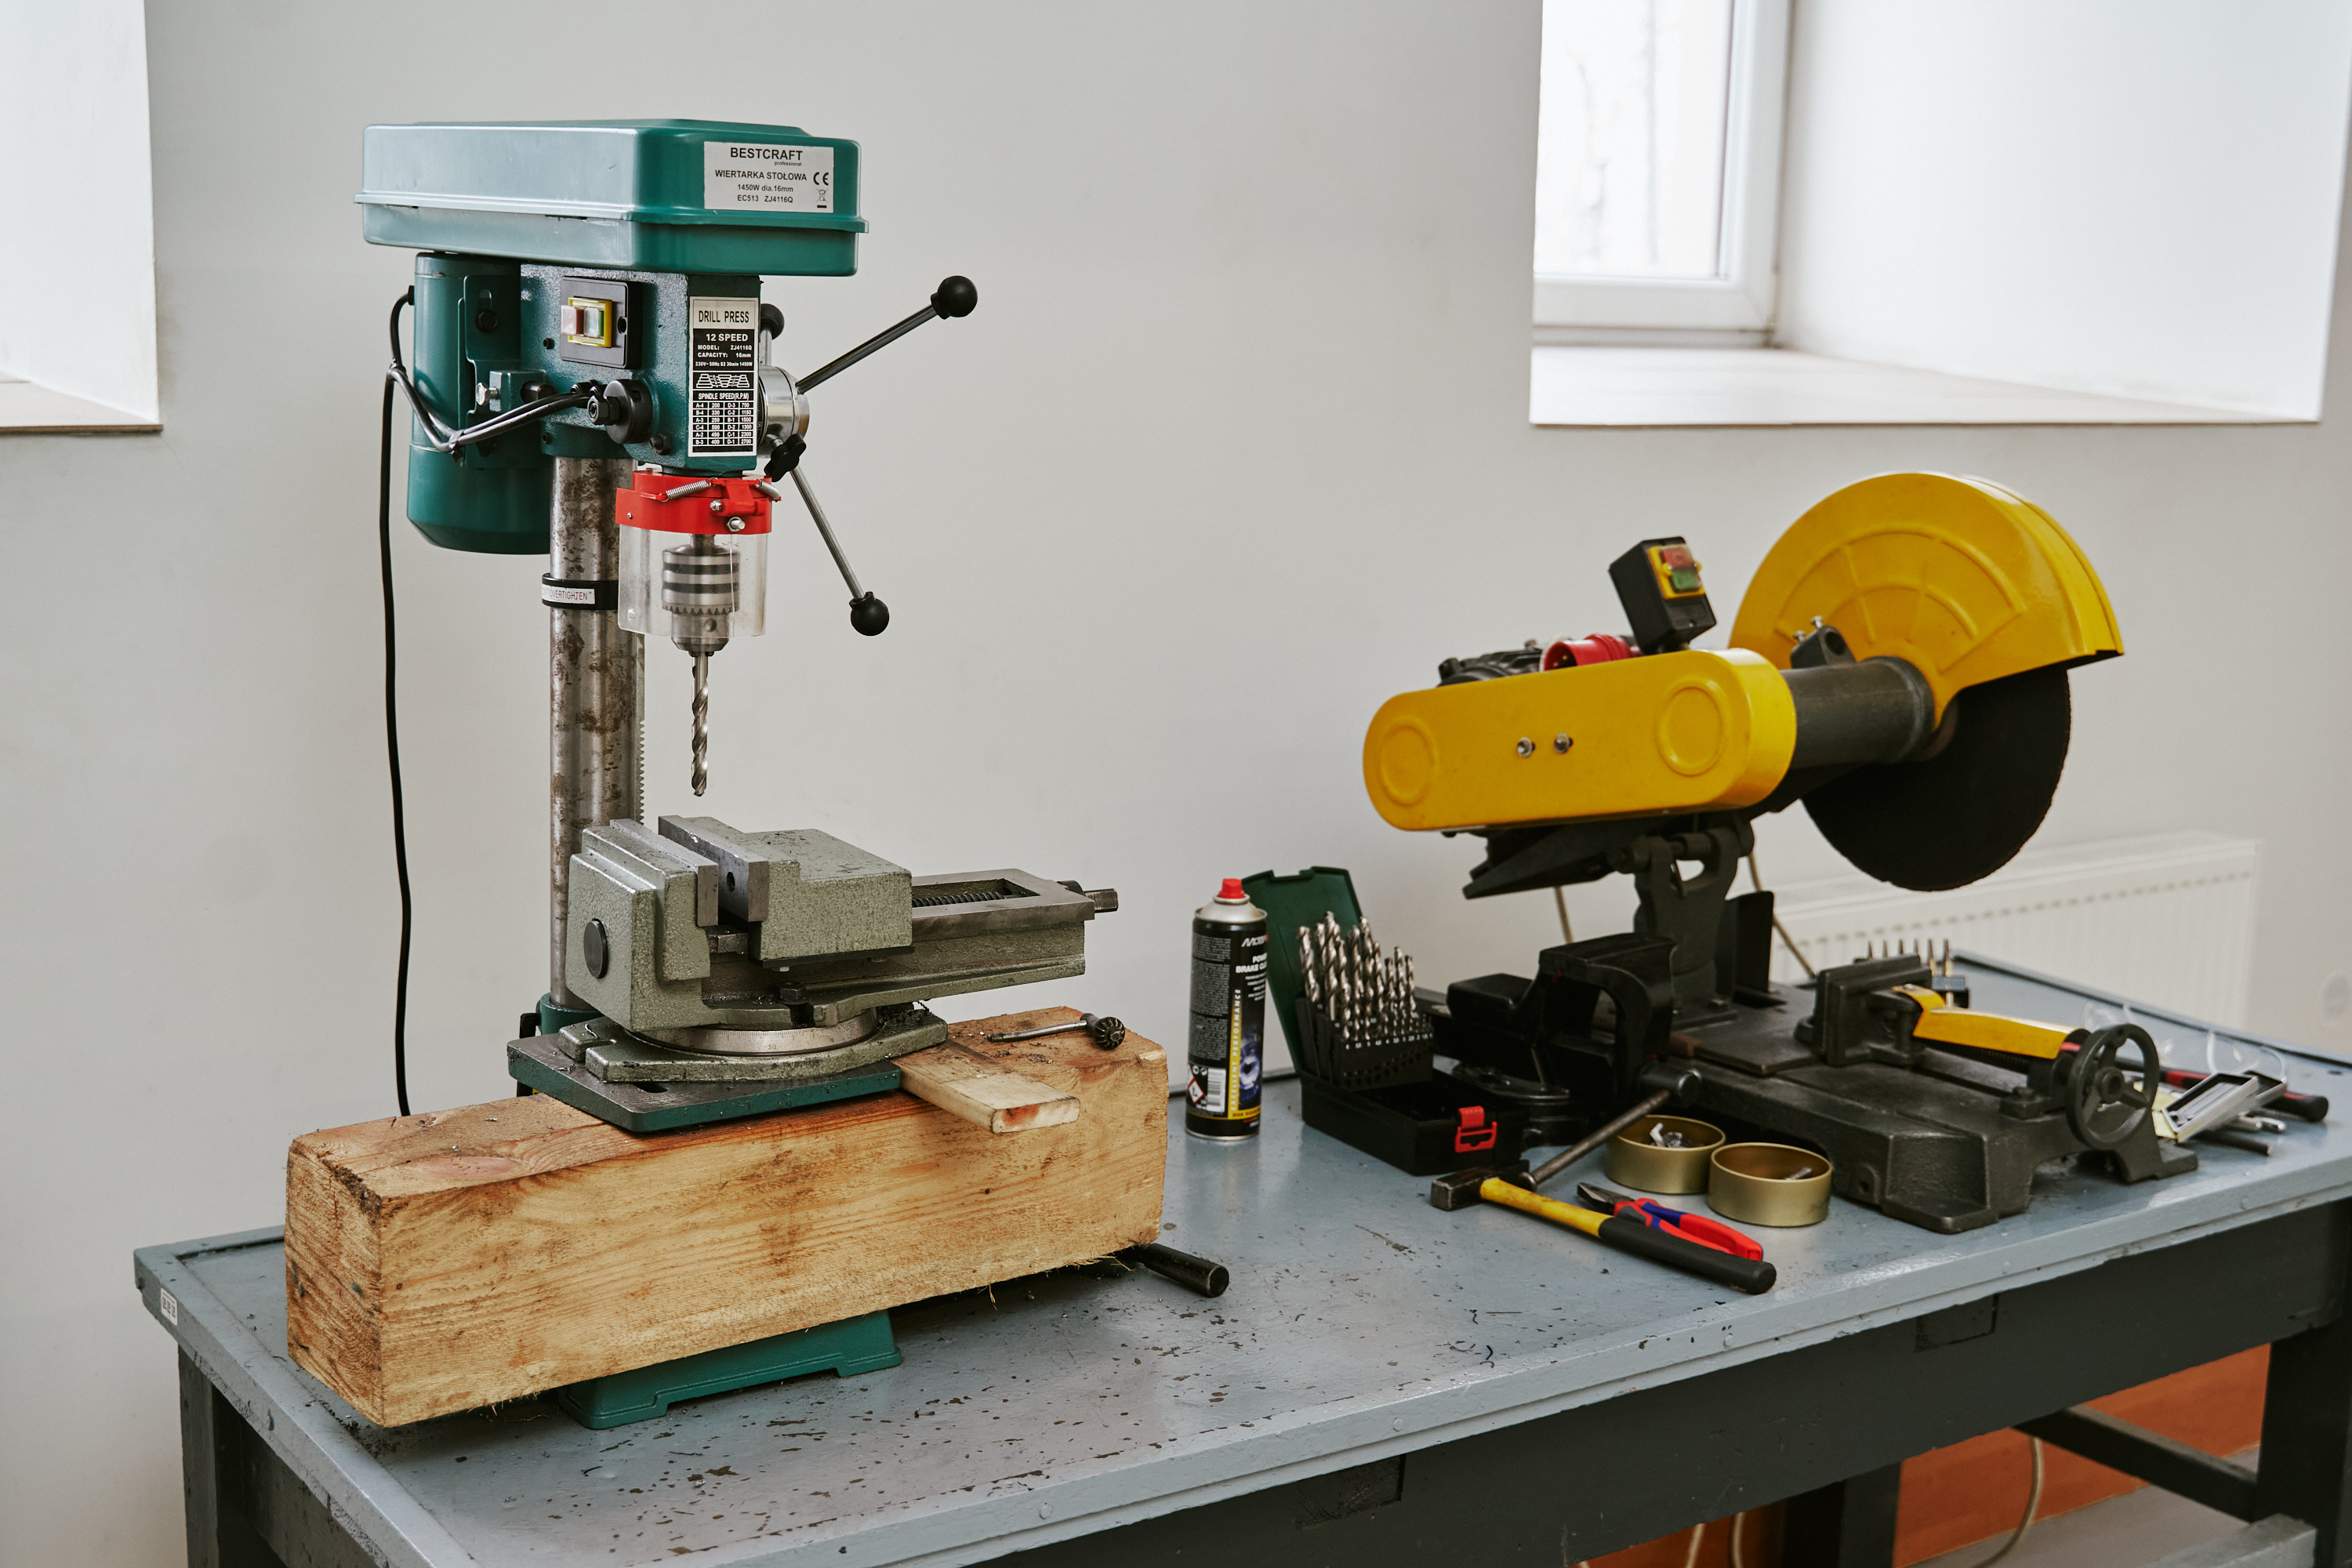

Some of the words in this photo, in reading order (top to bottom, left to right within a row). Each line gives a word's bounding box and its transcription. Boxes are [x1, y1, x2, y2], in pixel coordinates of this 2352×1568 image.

[730, 147, 803, 161] BESTCRAFT
[715, 169, 764, 179] WIERTARKA
[767, 172, 807, 181] STOŁOWA
[764, 195, 793, 204] ZJ4116Q
[699, 310, 720, 322] DRILL
[724, 310, 750, 323] PRESS
[718, 333, 748, 342] SPEED
[1236, 964, 1258, 973] BRAKE
[1232, 989, 1241, 1057] PERFORMANCE
